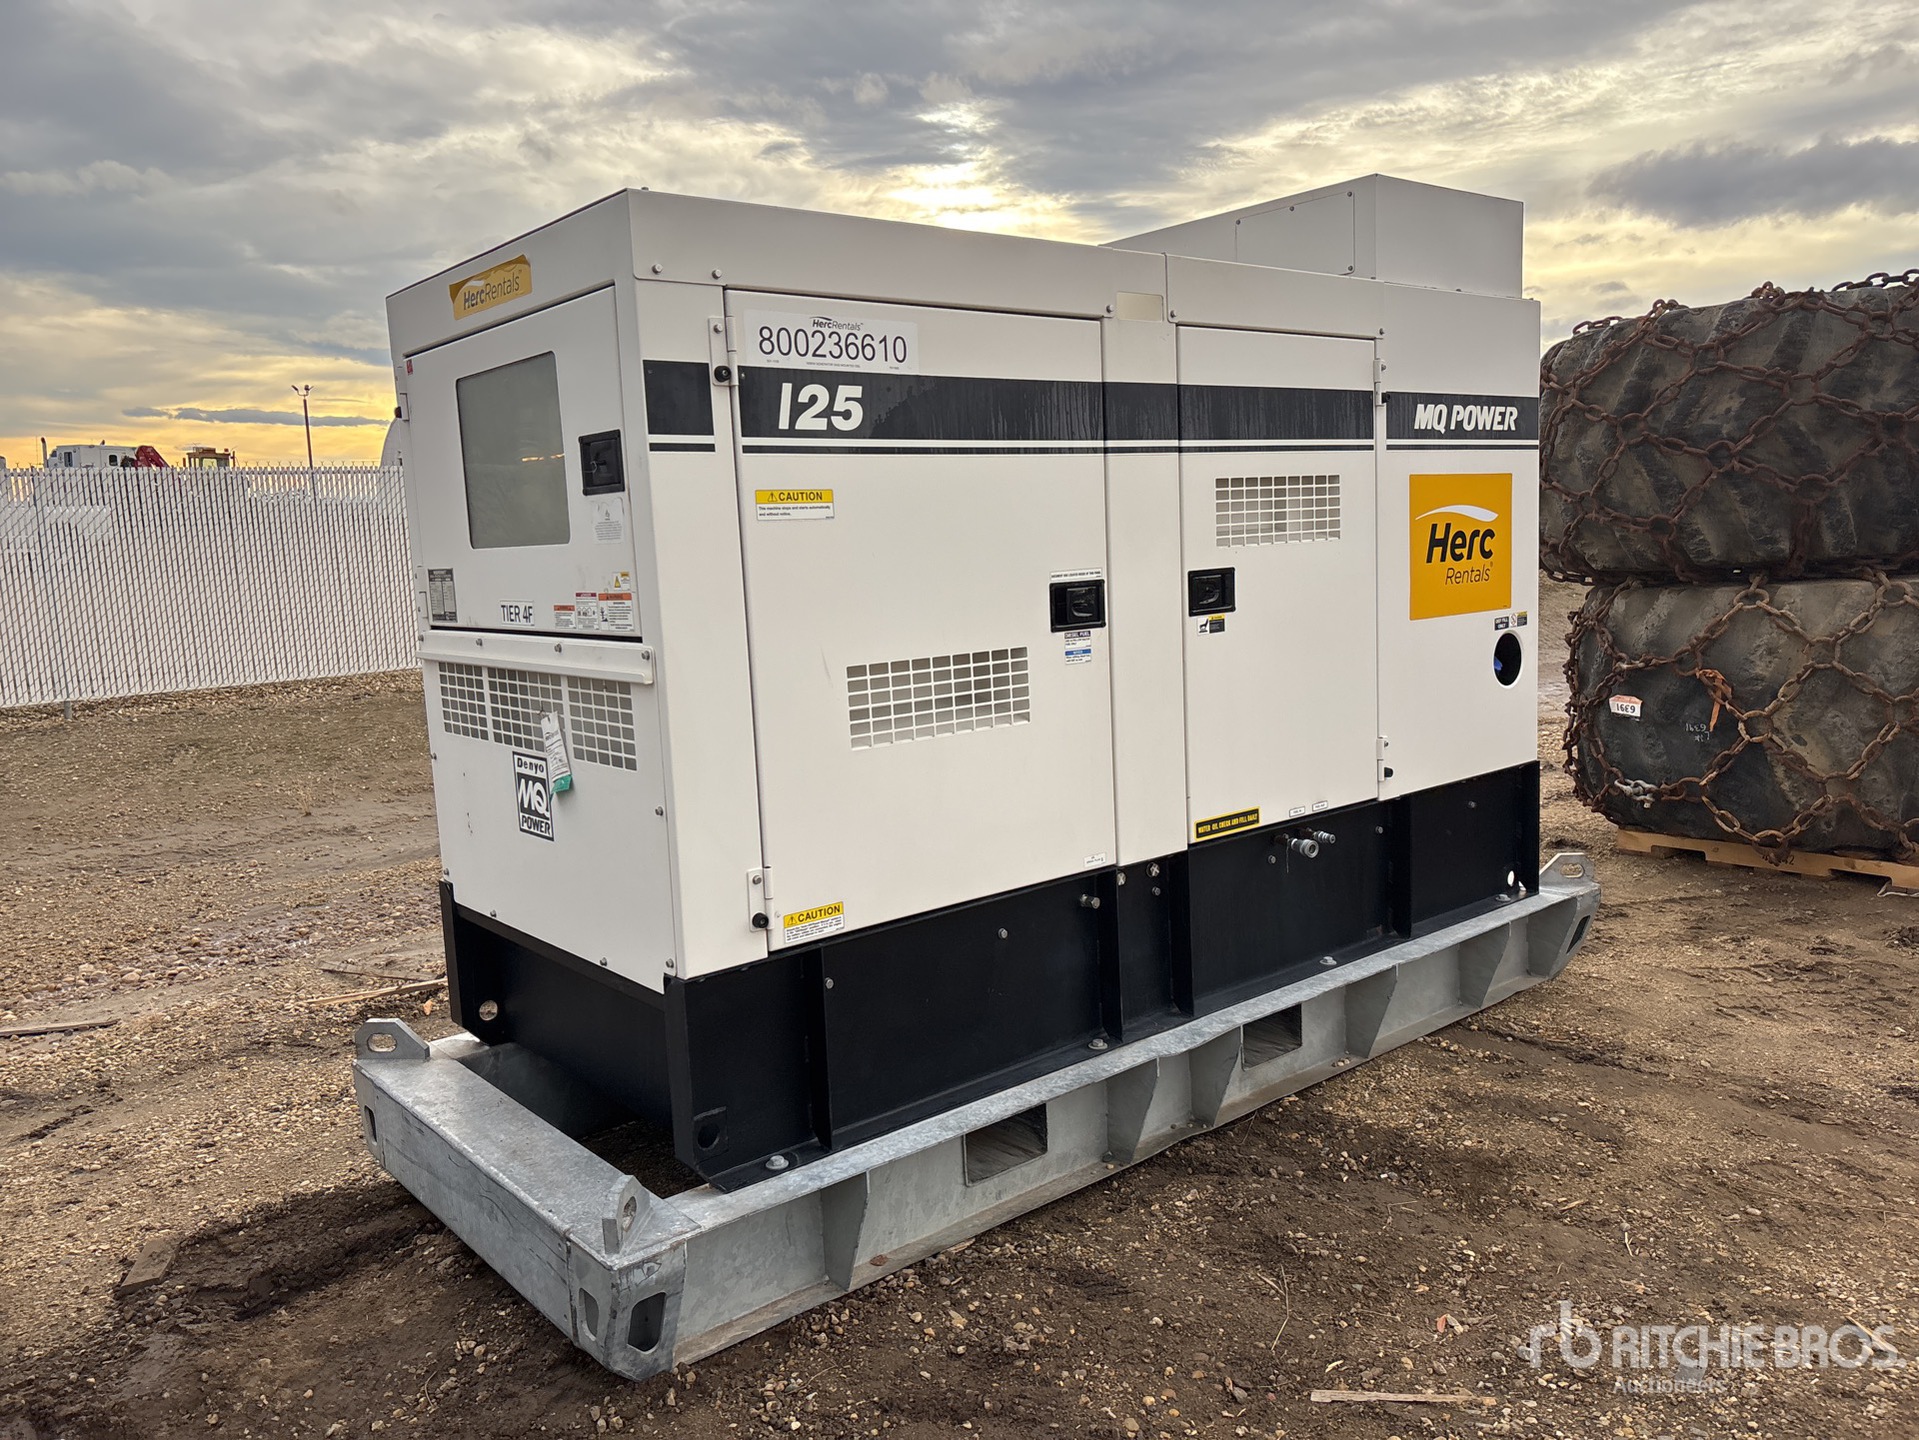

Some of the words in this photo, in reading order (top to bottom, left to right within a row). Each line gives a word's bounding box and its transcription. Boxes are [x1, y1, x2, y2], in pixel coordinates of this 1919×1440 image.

[759, 326, 907, 364] 800236610
[778, 382, 864, 431] 125
[1414, 403, 1448, 434] MQ
[1450, 404, 1518, 431] POWER
[778, 491, 823, 502] CAUTION
[1426, 522, 1496, 564] Herc
[501, 604, 521, 622] TIER
[522, 605, 533, 623] 4F
[1616, 703, 1635, 713] 6391
[517, 757, 544, 774] Denyo
[518, 778, 550, 818] MQ
[521, 815, 551, 835] POWER
[797, 904, 841, 922] CAUTION
